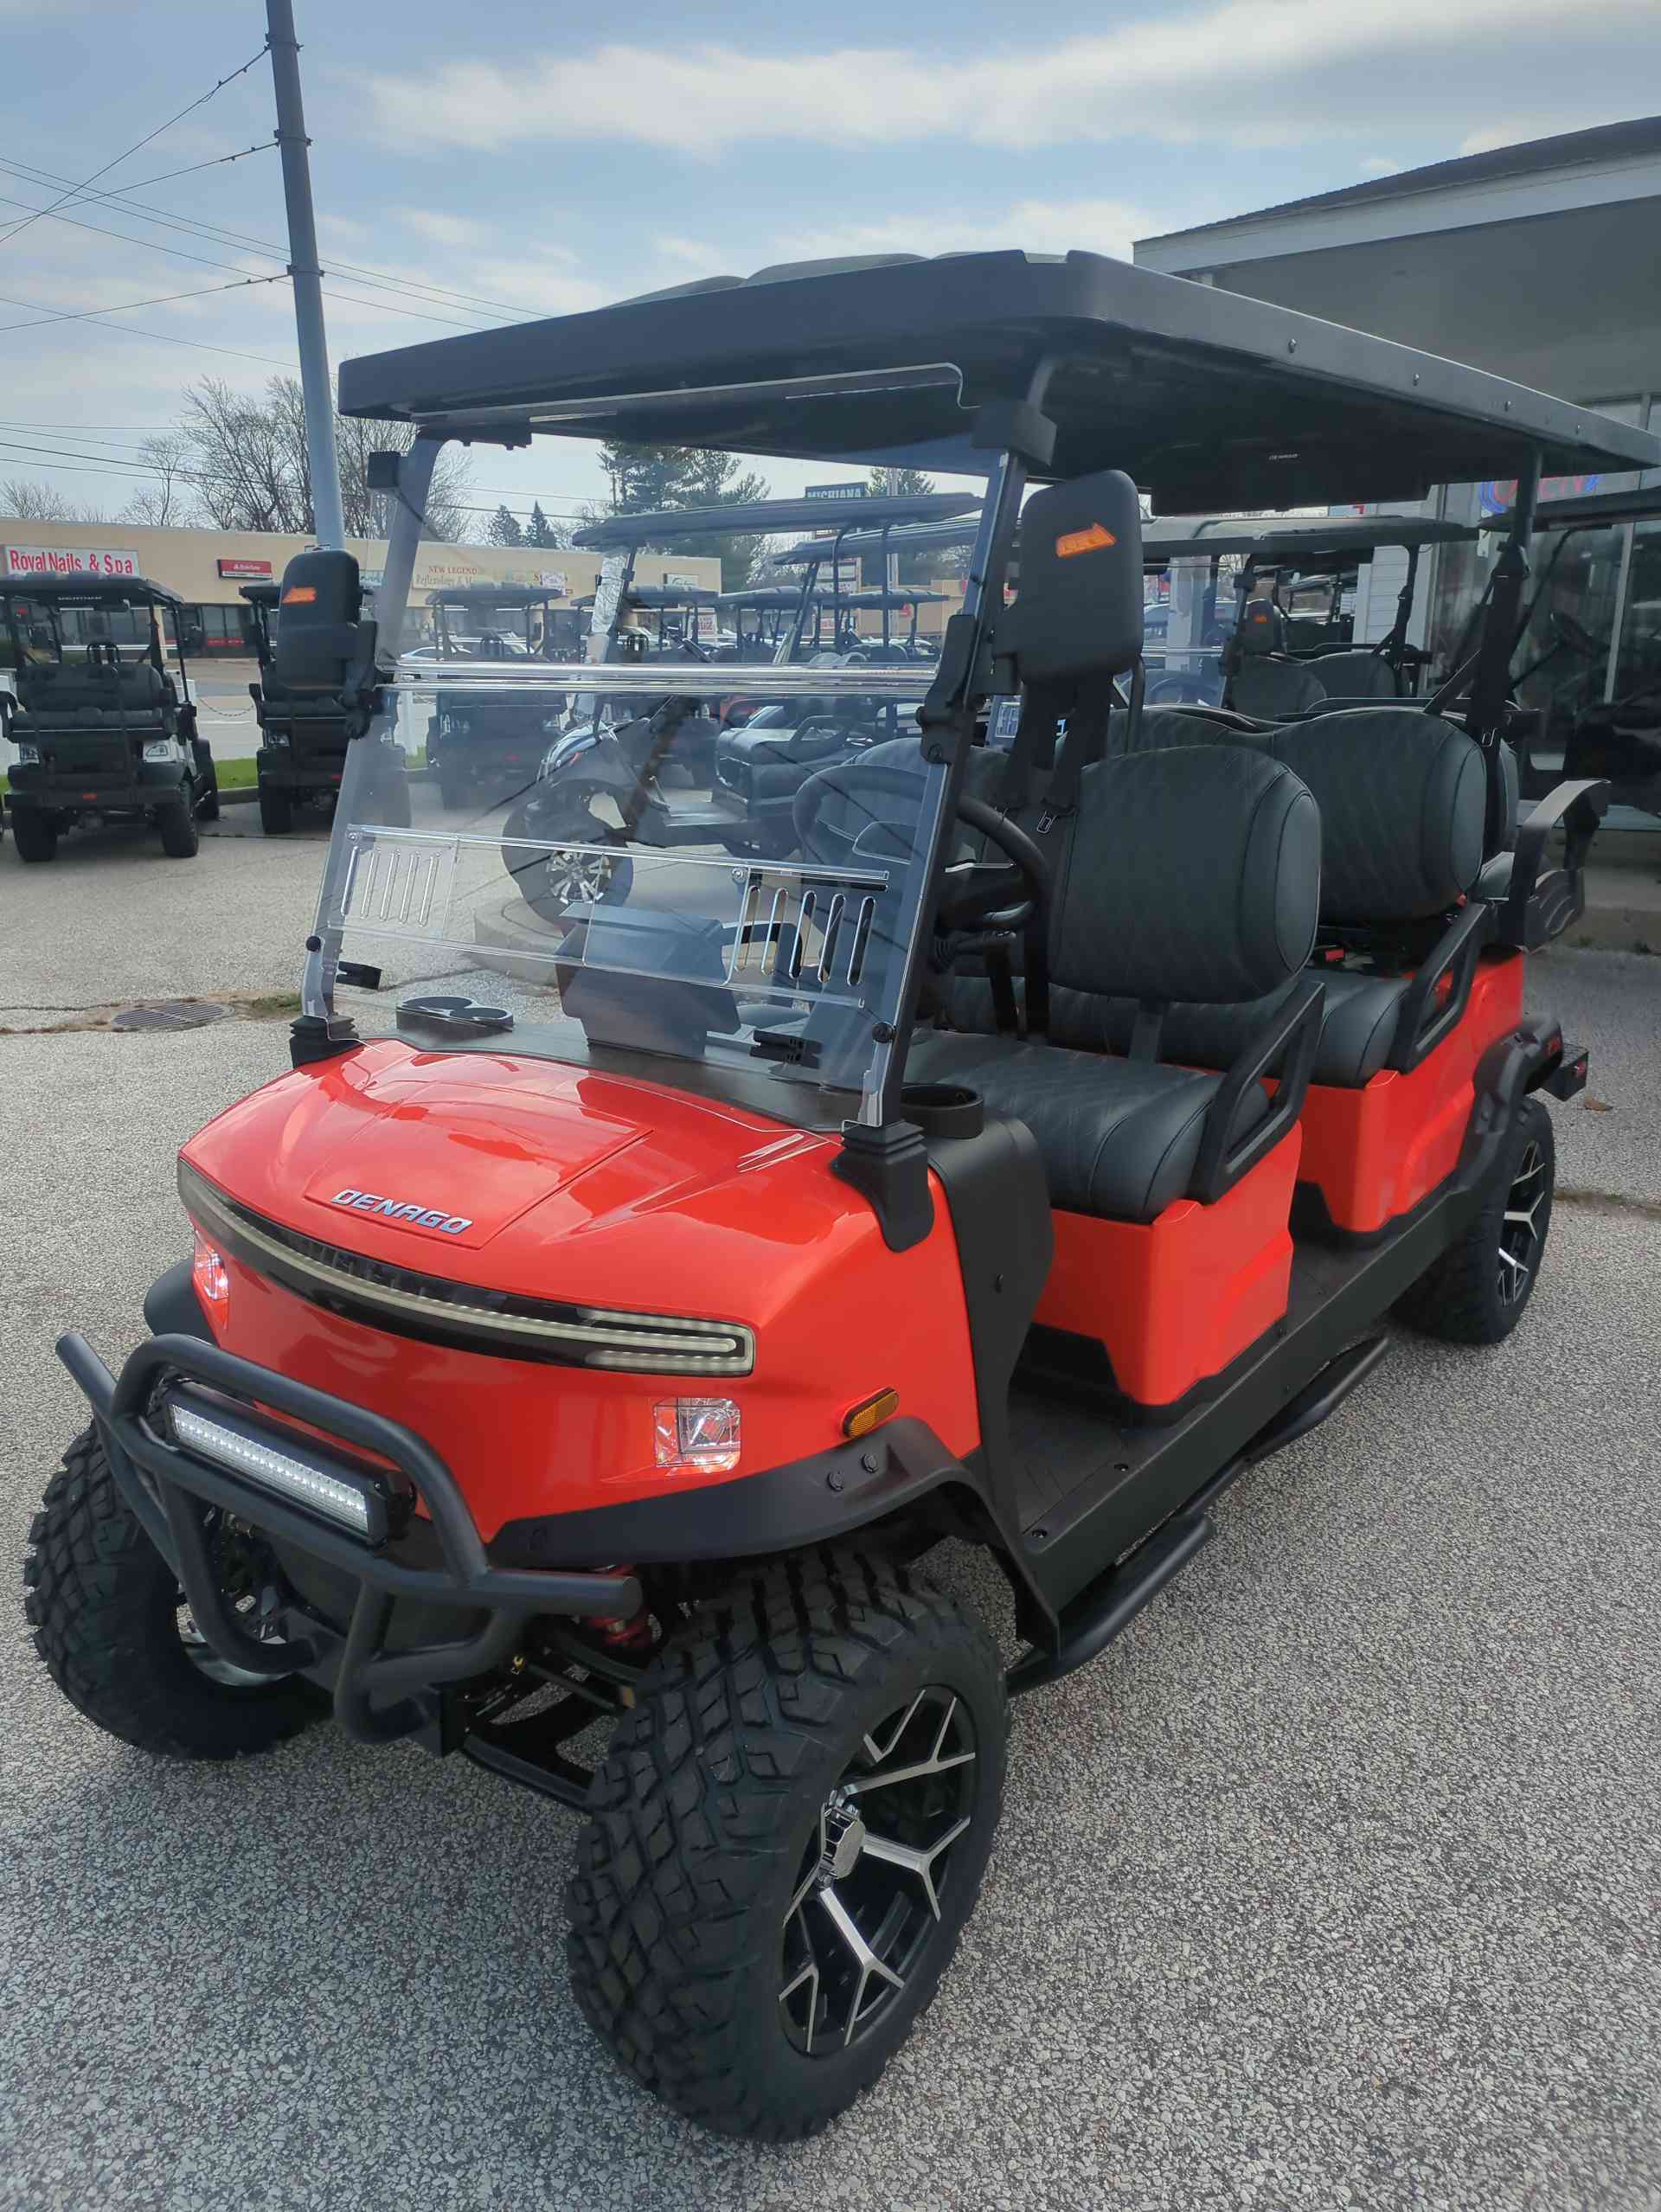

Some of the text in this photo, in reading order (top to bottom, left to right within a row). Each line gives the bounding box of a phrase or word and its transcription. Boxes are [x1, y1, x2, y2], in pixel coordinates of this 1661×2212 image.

[10, 549, 133, 574] Royal Nails & Spa
[331, 1189, 473, 1234] DENAGO
